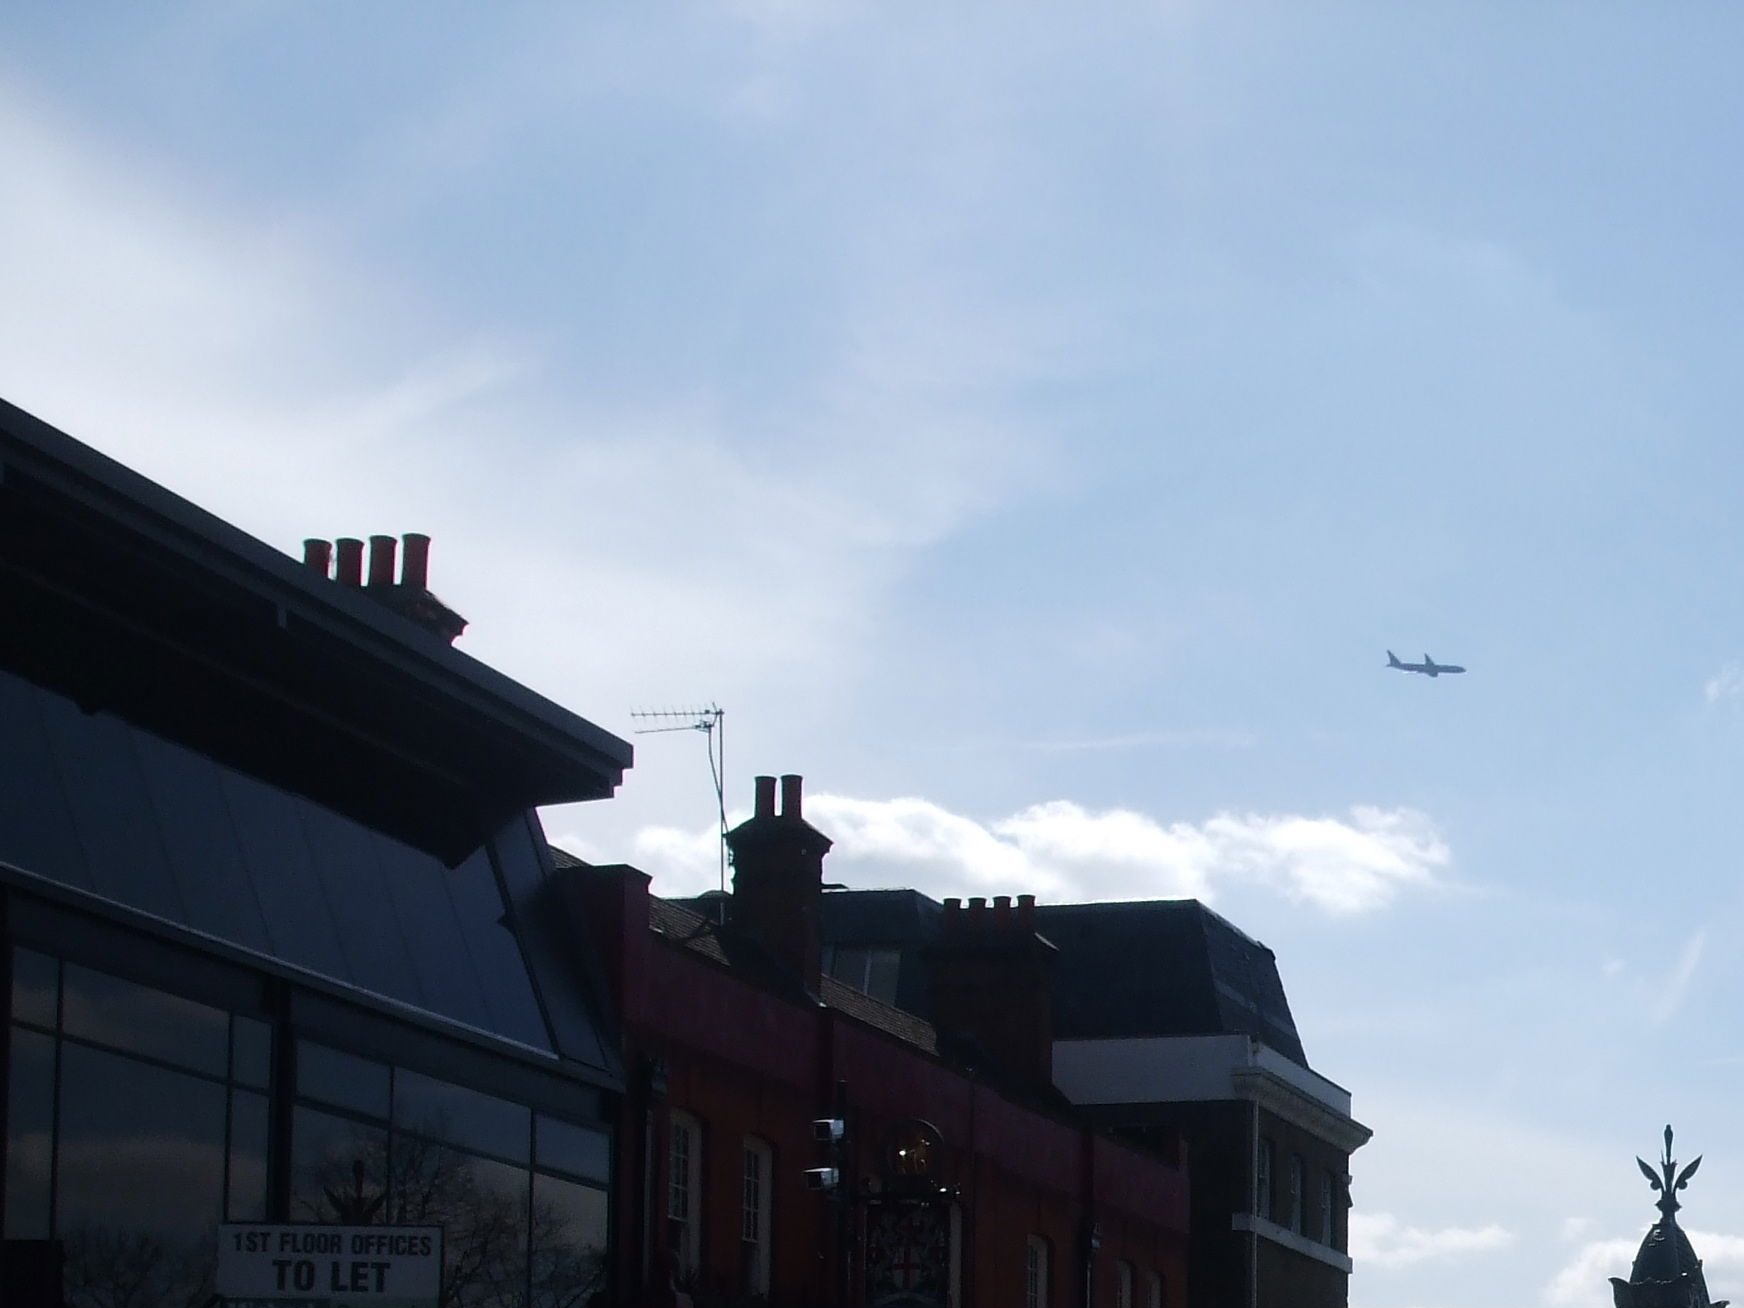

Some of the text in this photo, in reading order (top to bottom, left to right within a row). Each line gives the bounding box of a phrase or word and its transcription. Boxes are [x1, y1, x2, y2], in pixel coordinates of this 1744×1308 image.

[234, 1232, 431, 1256] 1ST FLOOR OFFICES
[272, 1259, 391, 1292] TO LET
